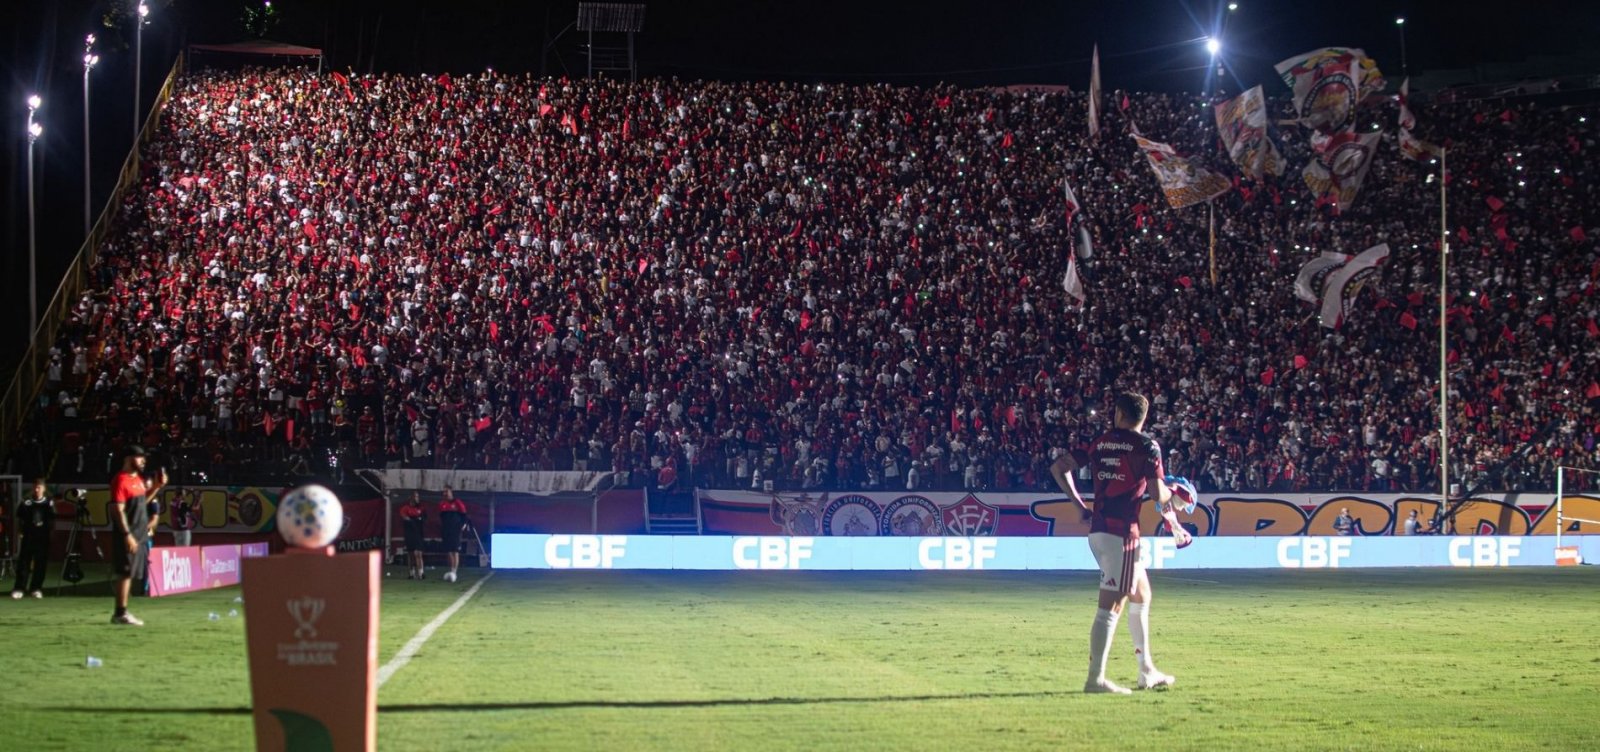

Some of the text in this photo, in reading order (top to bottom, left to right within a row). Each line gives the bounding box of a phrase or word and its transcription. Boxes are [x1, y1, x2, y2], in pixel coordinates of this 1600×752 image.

[882, 501, 902, 529] TORCIDA
[544, 535, 627, 568] CBF
[732, 535, 812, 568] CBF
[918, 535, 998, 568] CBF
[1139, 536, 1177, 568] BF
[1277, 536, 1352, 567] CBF
[1448, 536, 1520, 567] CBF
[162, 550, 192, 591] Betano
